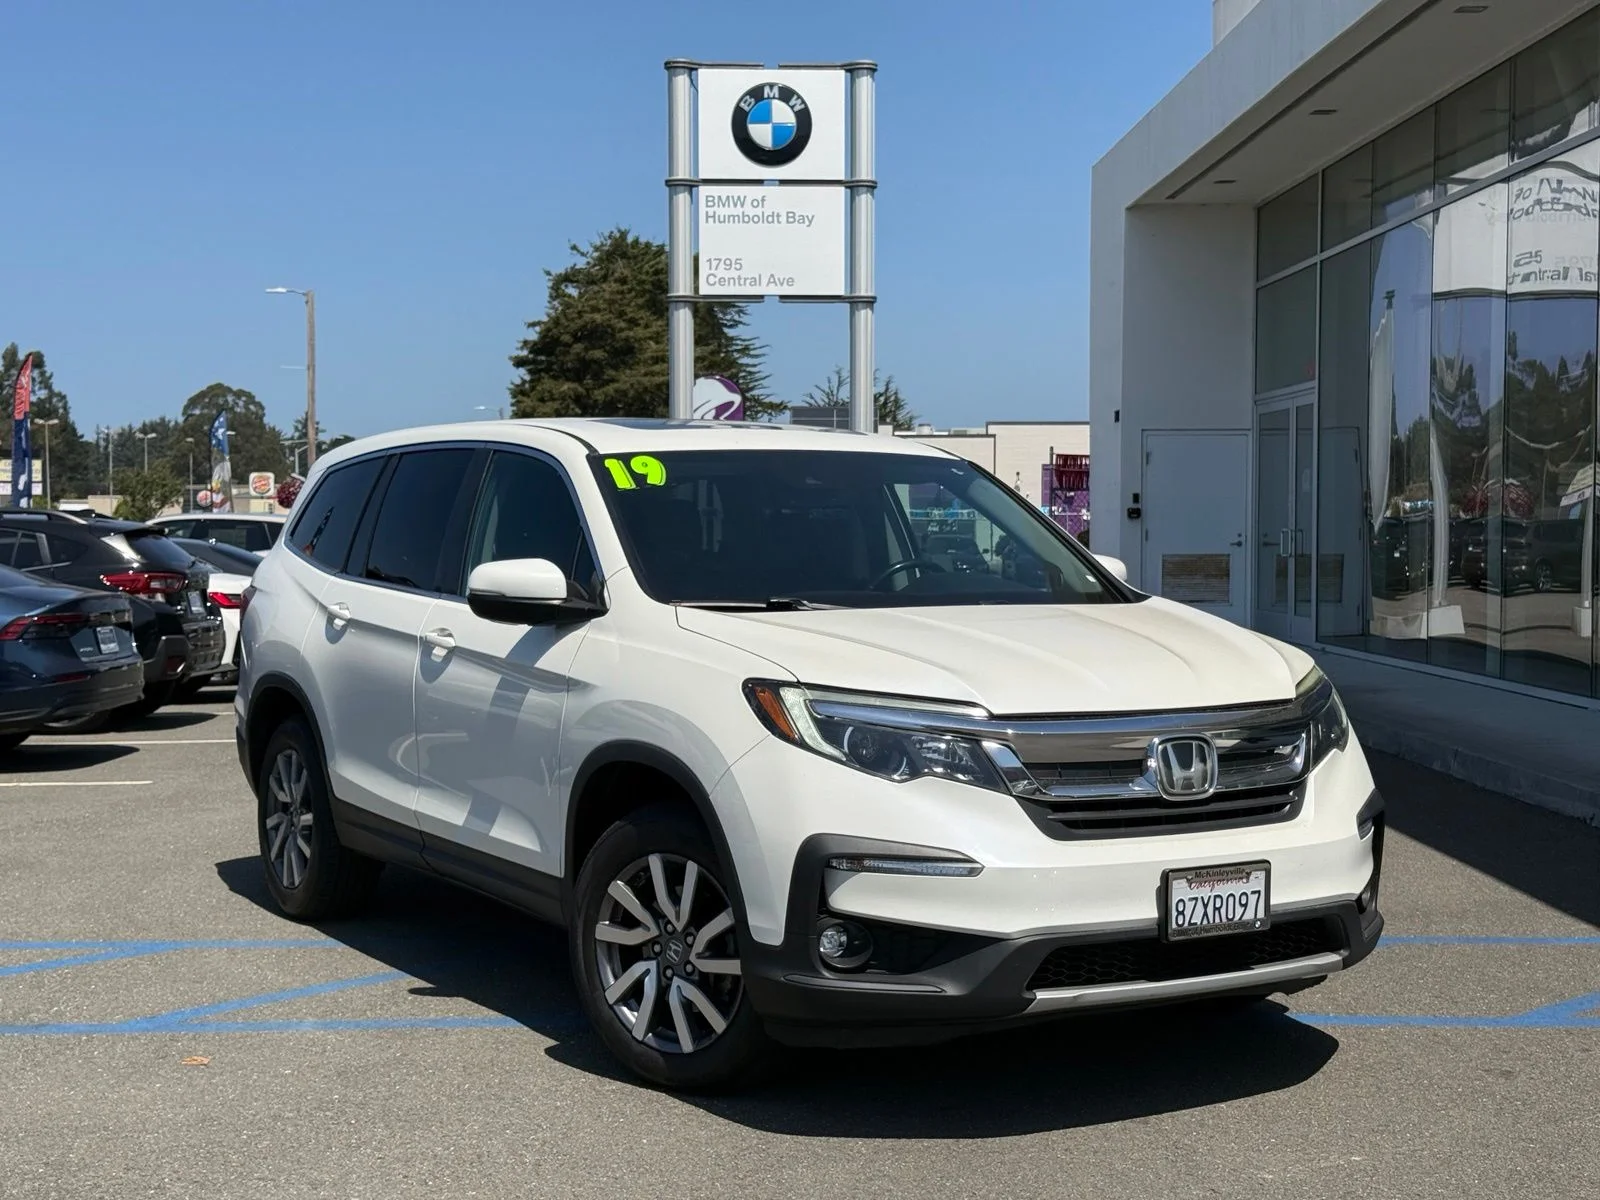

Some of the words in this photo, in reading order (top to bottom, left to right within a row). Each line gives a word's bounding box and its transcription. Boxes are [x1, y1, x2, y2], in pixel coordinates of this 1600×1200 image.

[739, 85, 805, 113] BMW
[705, 195, 747, 208] BMW
[750, 195, 766, 208] of
[705, 211, 781, 224] Humboldt
[786, 211, 814, 227] Bay
[706, 258, 743, 270] 1795
[705, 273, 761, 286] Central
[766, 273, 795, 286] Ave
[604, 455, 667, 489] 19
[1194, 868, 1245, 879] McKinleyville
[1175, 890, 1261, 928] 8ZXR097
